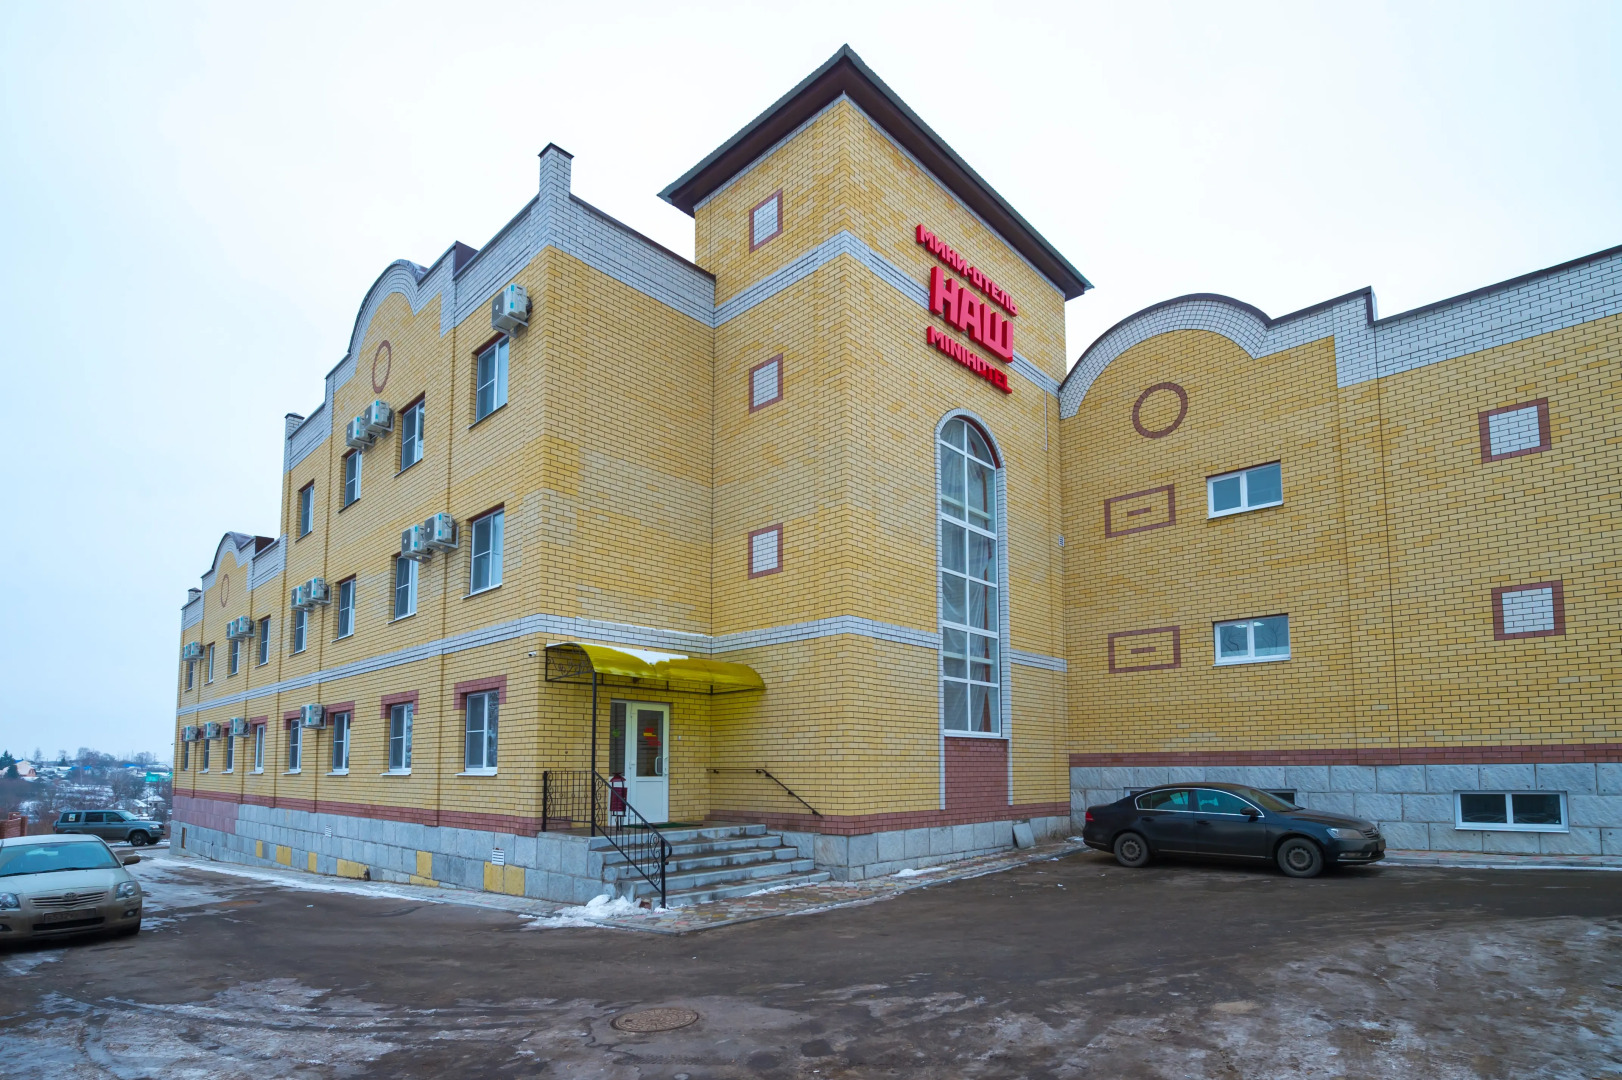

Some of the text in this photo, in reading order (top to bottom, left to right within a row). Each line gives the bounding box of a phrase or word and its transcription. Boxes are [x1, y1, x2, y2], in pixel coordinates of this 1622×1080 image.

[917, 224, 1018, 317] МИНИ-ОТЕЛЬ
[929, 266, 1013, 363] НАШ
[927, 326, 1012, 394] MINIHOTEL
